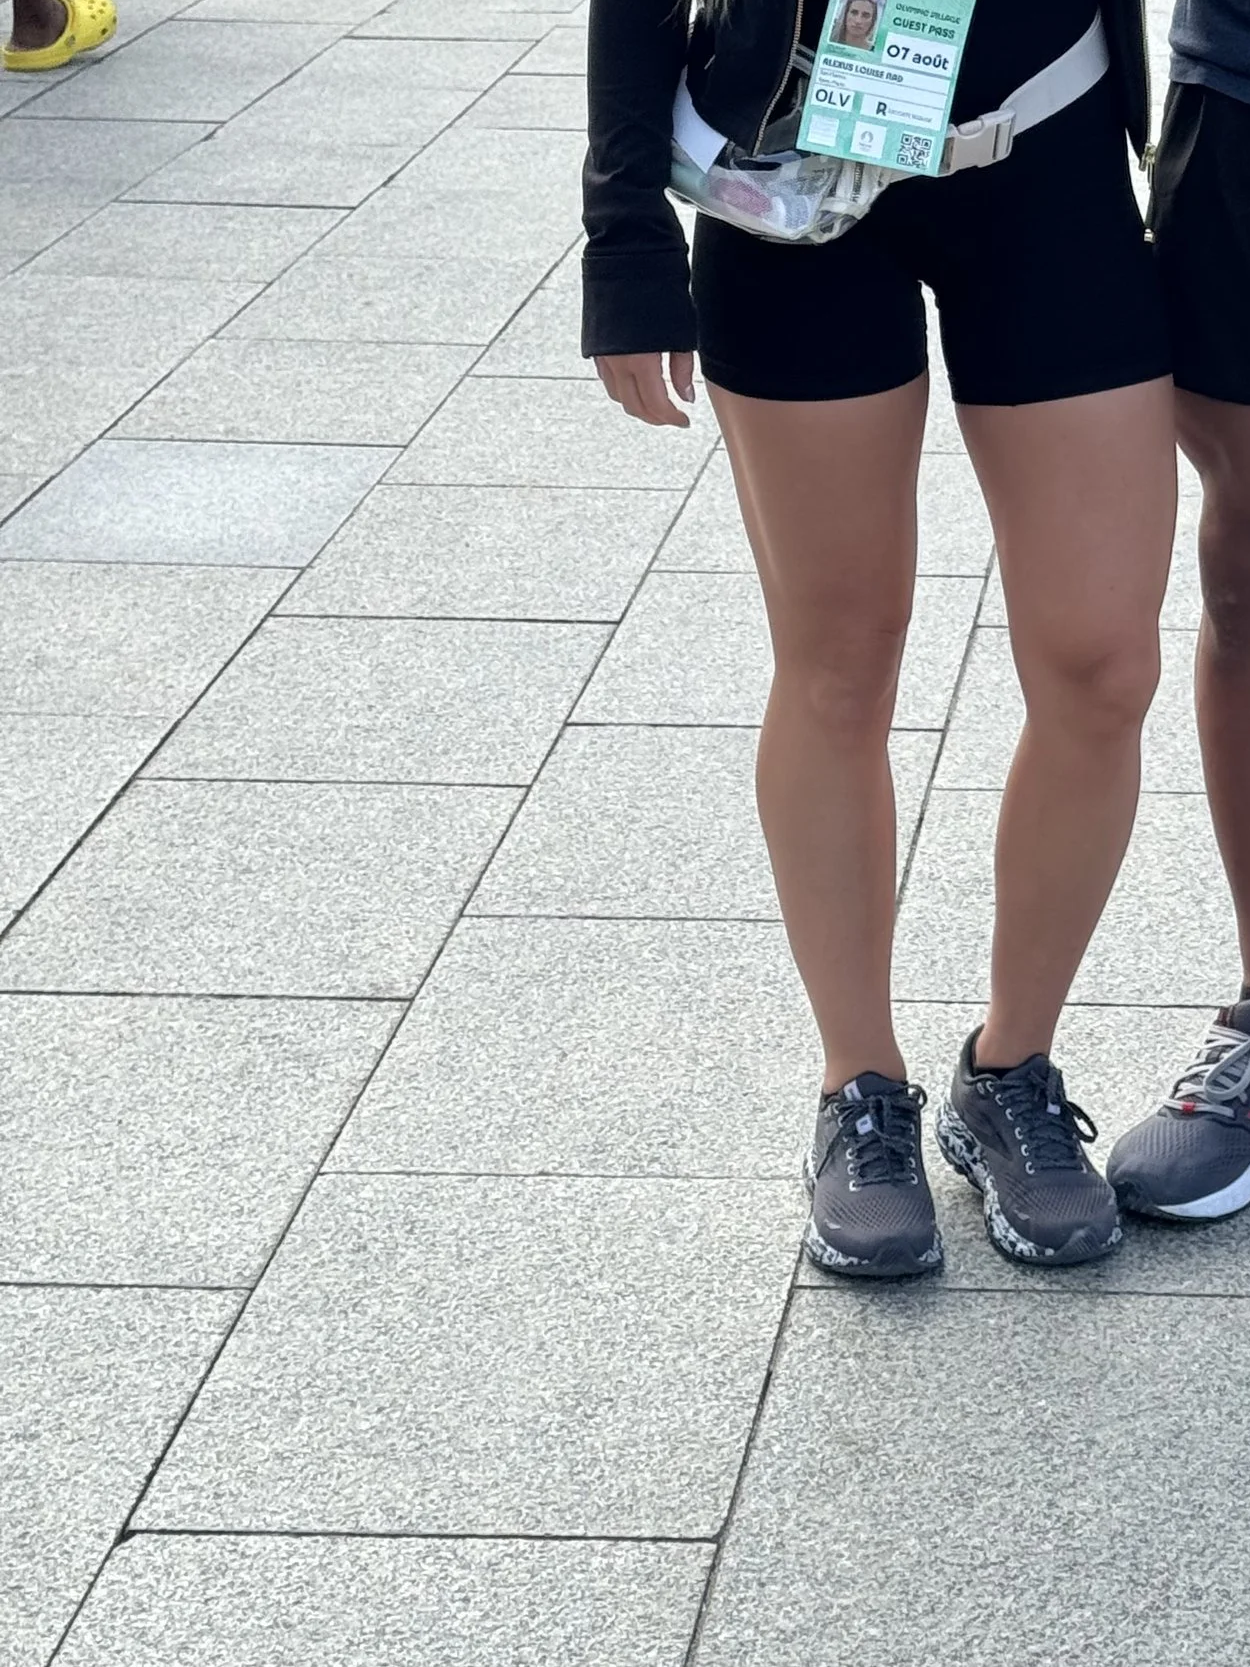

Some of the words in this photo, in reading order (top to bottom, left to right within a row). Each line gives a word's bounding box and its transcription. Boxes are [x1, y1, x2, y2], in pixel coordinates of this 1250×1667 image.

[928, 25, 956, 40] PASS
[912, 53, 950, 71] août
[815, 89, 851, 108] OLV
[875, 101, 888, 117] R
